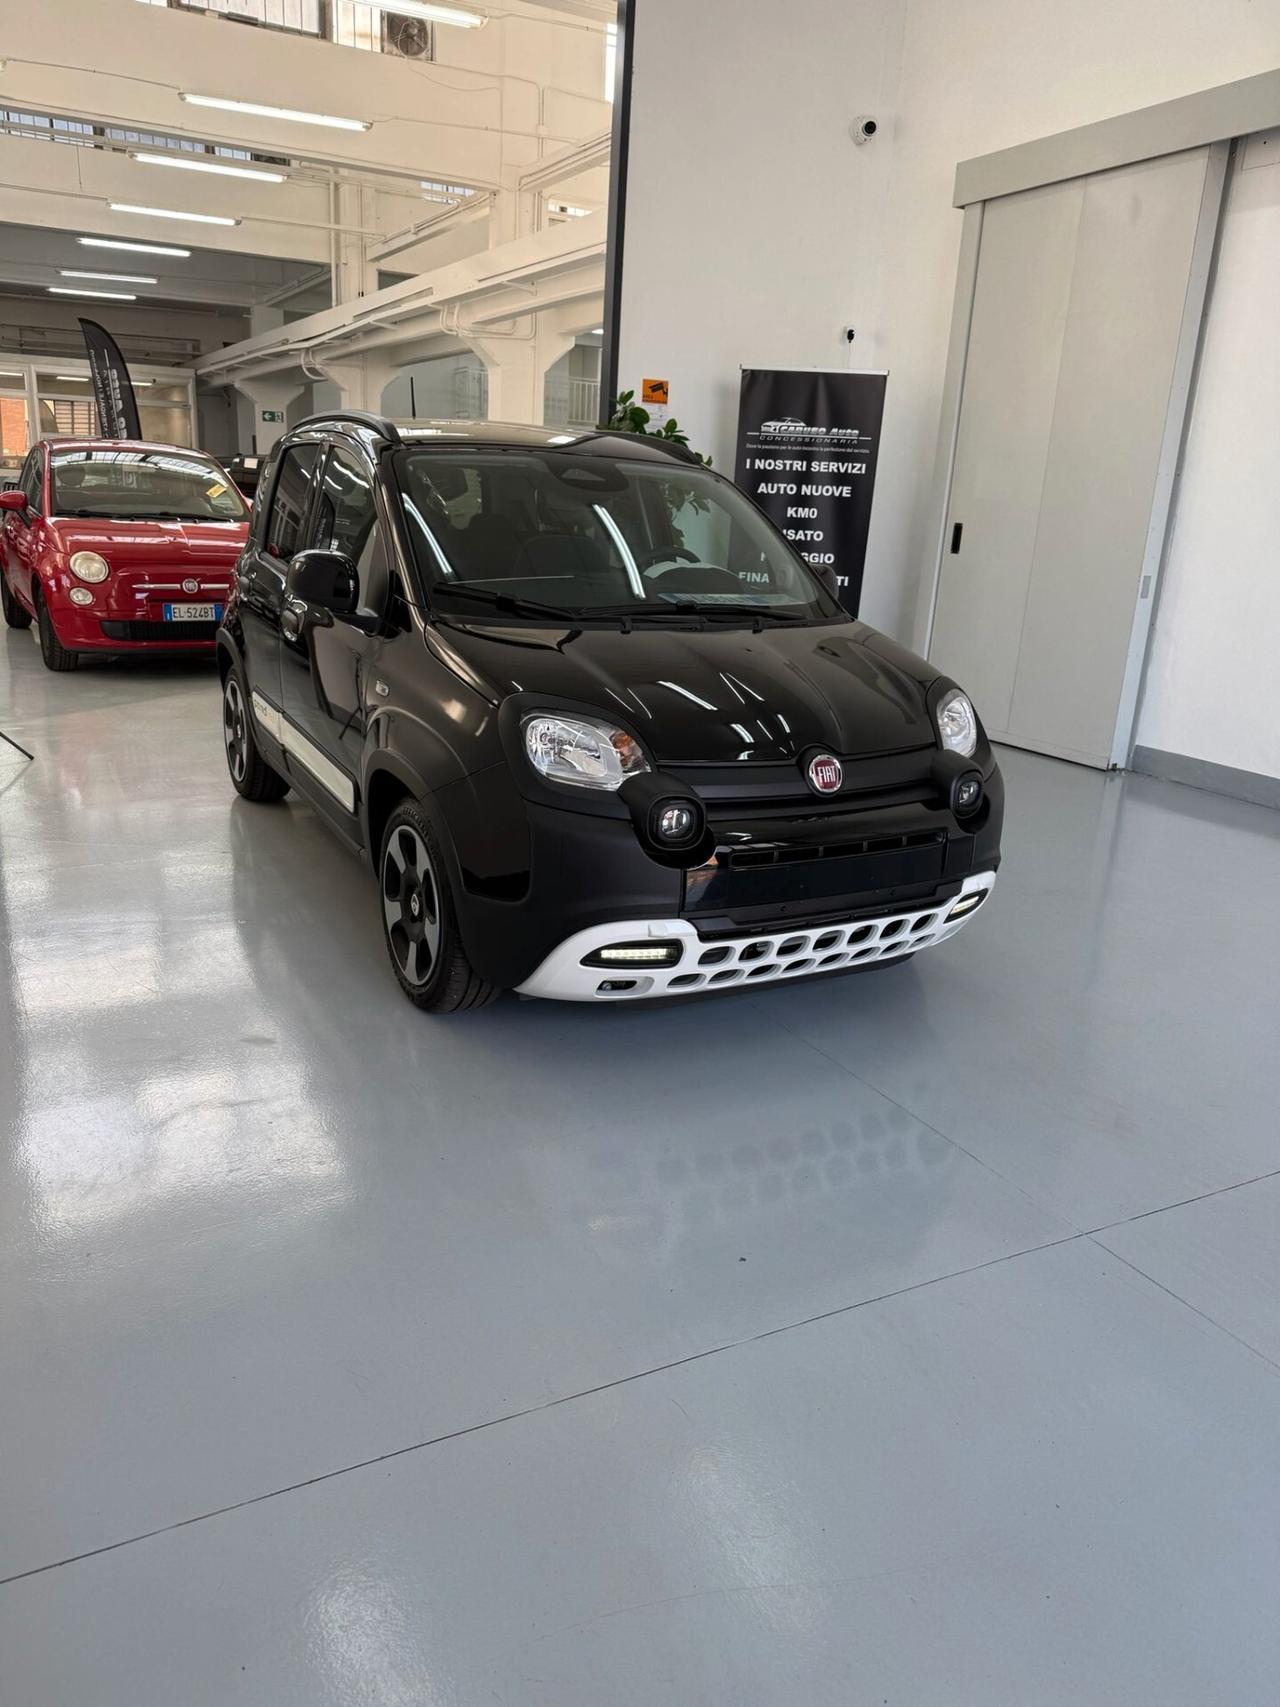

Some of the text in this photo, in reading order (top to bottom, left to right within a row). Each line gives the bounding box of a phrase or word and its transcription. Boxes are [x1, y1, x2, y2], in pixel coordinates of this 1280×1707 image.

[759, 435, 858, 444] CONCESSIONARIA
[745, 458, 866, 474] I NOSTRI SERVIZI
[757, 483, 852, 497] AUTO NUOVE
[817, 765, 836, 783] FIAT
